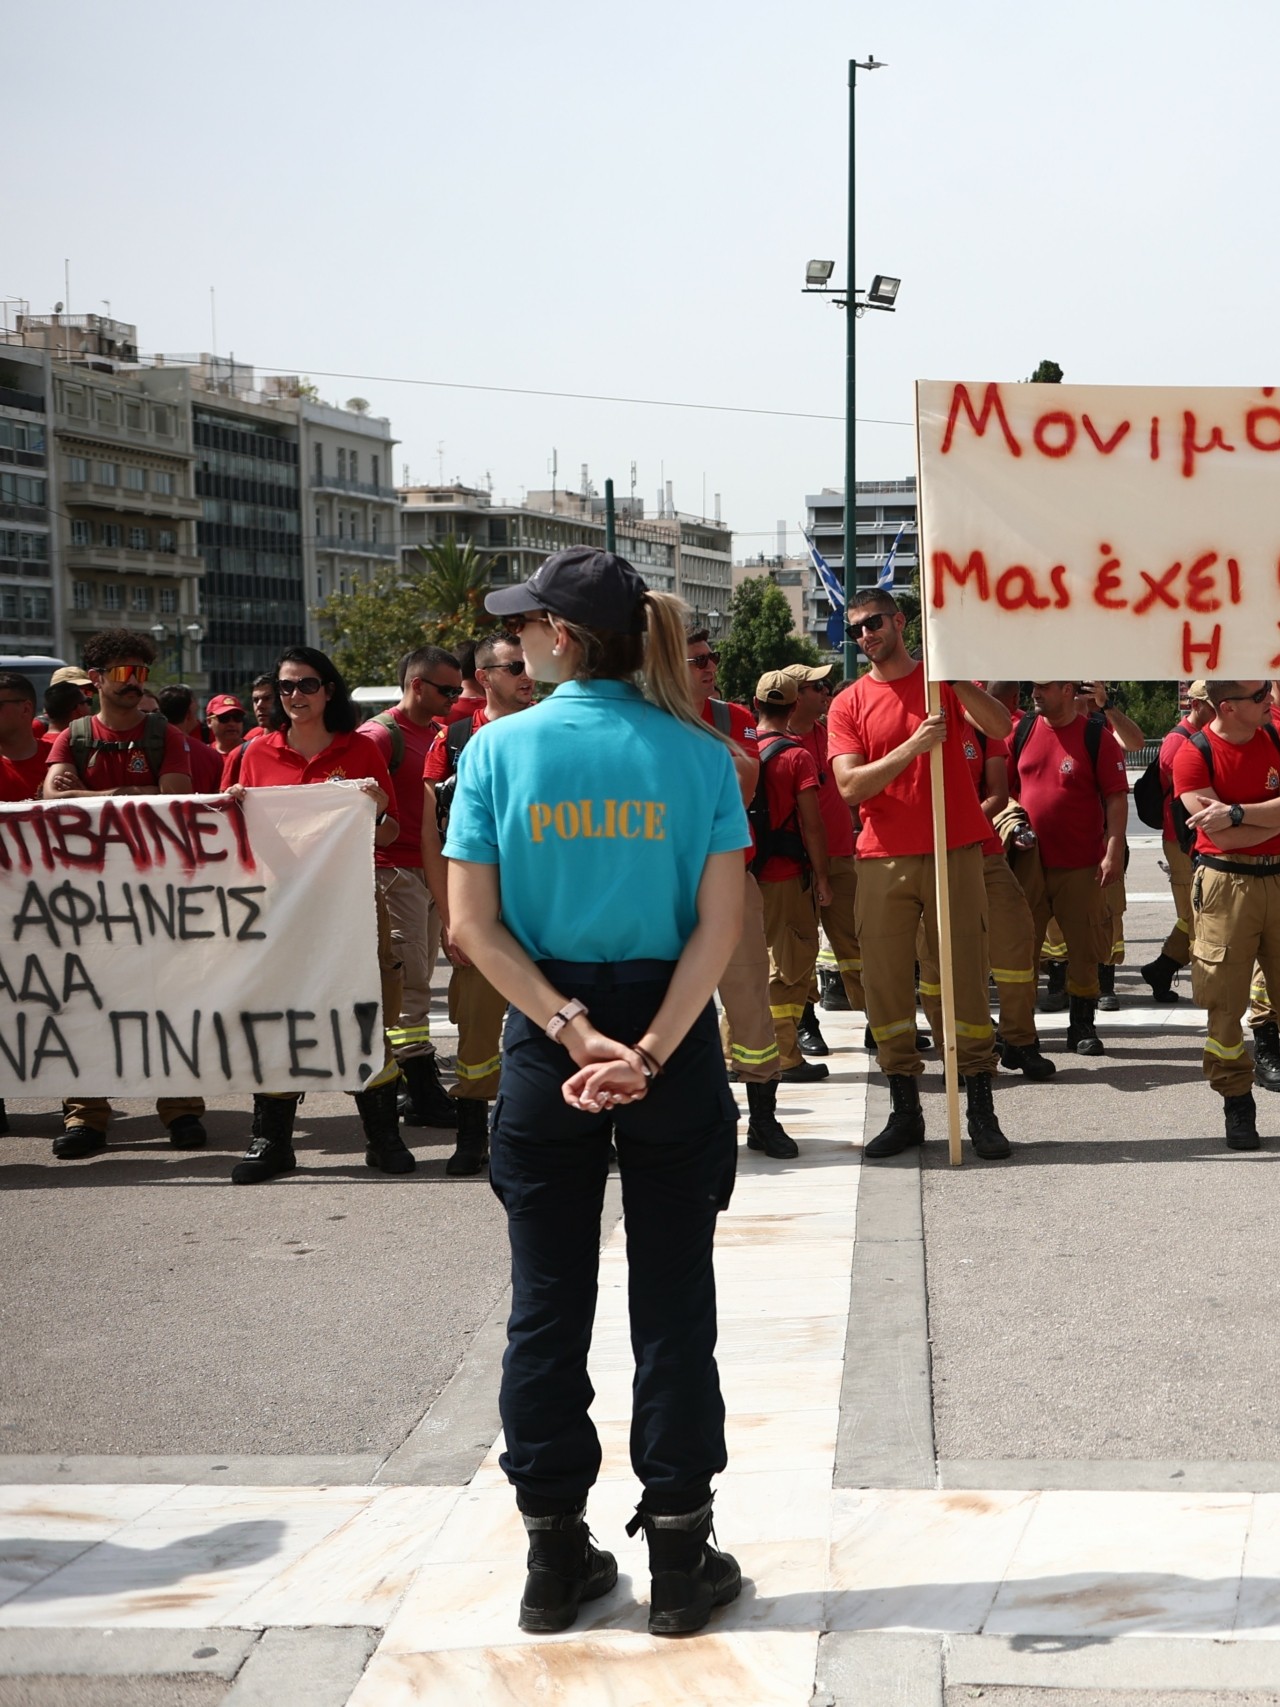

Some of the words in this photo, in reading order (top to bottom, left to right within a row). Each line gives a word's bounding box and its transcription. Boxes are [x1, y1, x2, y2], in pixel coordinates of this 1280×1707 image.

[931, 550, 1071, 611] Μας
[1091, 543, 1241, 615] έχει
[1181, 621, 1222, 674] Η
[529, 799, 666, 842] POLICE
[13, 880, 267, 948] ΑΦΗΝΕΙΣ
[109, 1002, 378, 1084] ΠΝΙΓΕΙ!
